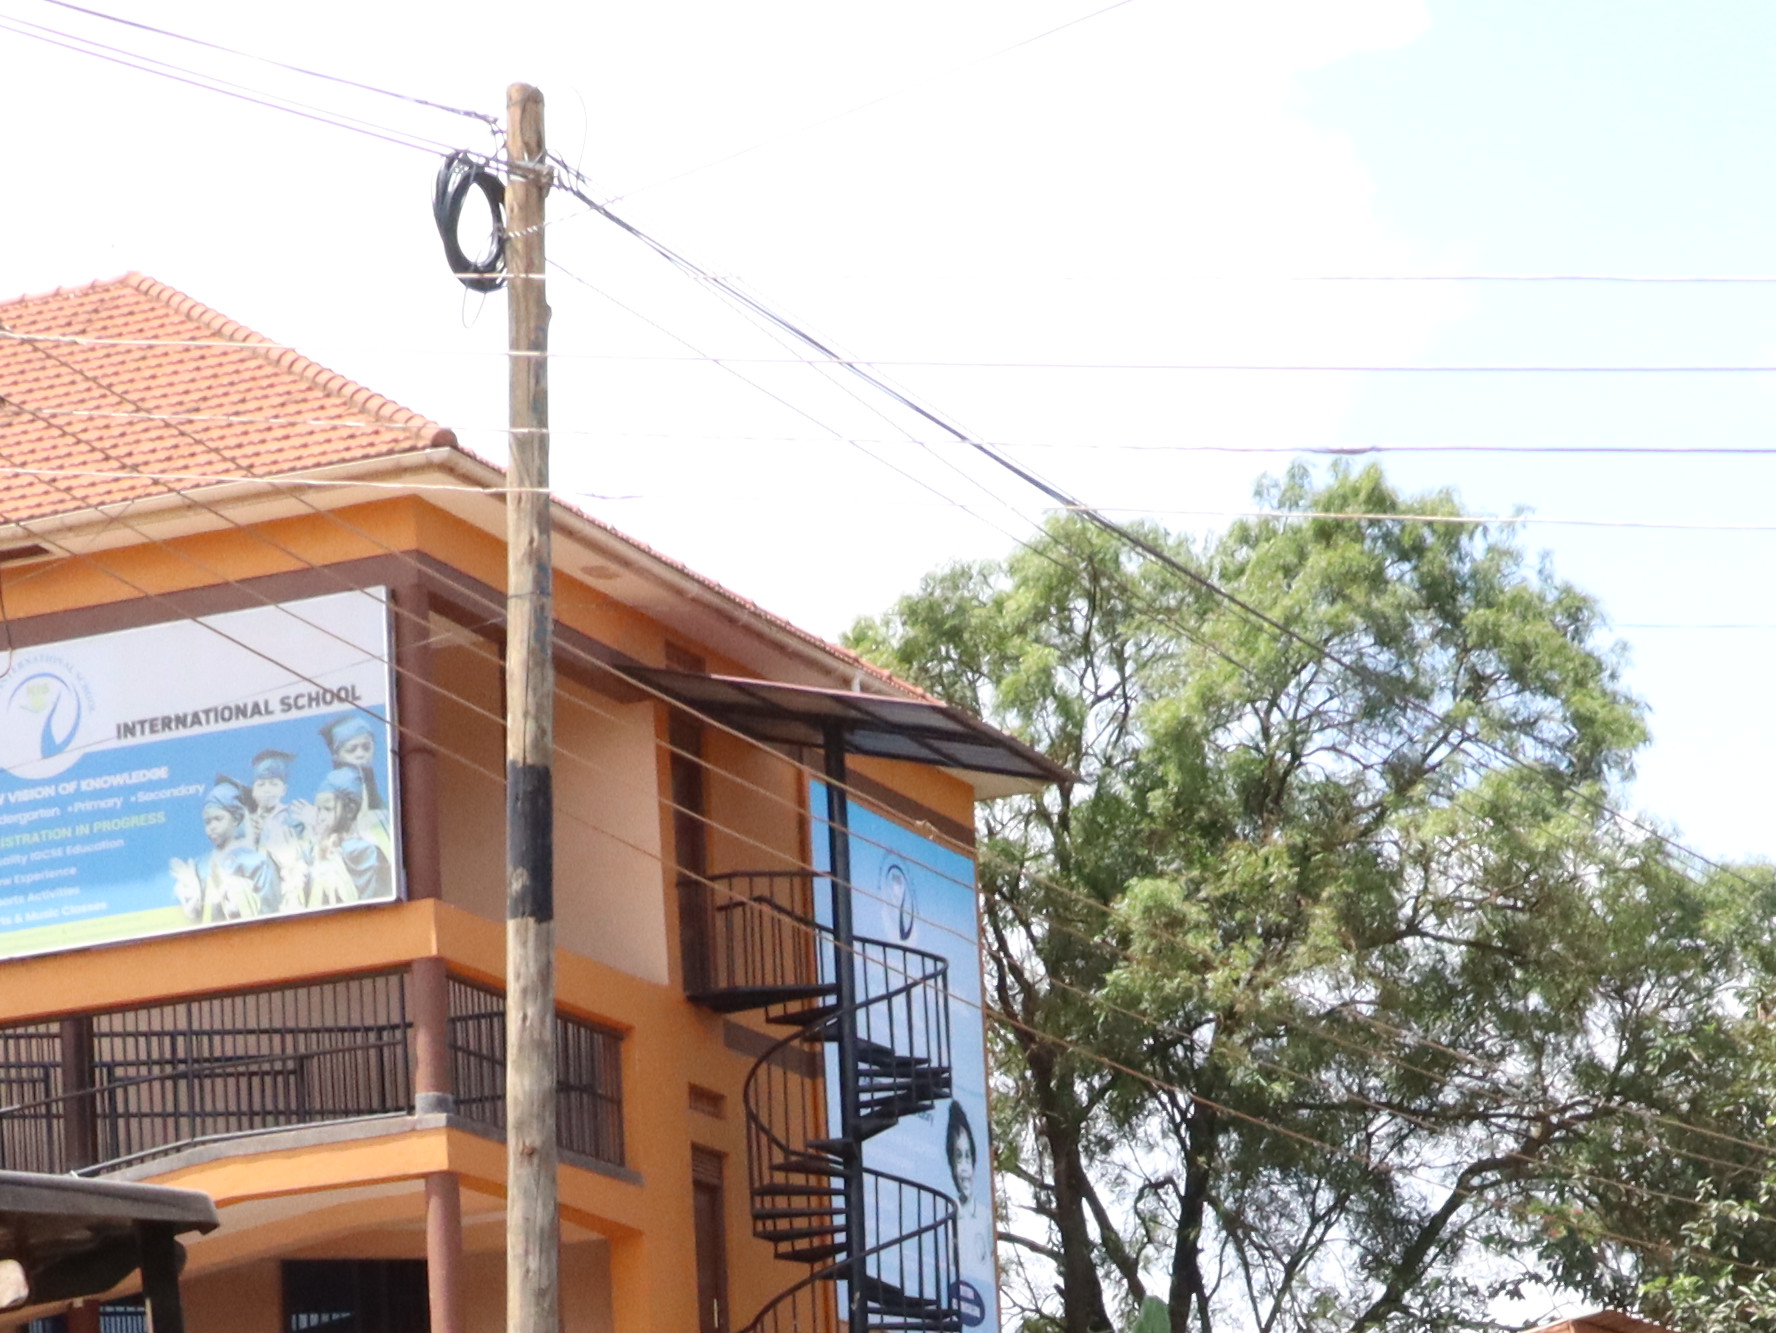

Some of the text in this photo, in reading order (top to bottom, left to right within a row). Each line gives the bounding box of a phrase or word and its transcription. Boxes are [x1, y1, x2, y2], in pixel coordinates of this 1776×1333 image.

[116, 684, 362, 740] INTERNATIONAL SCHOOL
[7, 786, 56, 803] VISION
[58, 781, 78, 795] OF
[80, 766, 169, 792] KNOWLEDGE
[75, 824, 90, 836] IN
[93, 811, 166, 833] PROGRESS
[66, 838, 124, 856] Education
[14, 866, 77, 884] Experience
[27, 886, 81, 903] Activities
[25, 908, 60, 922] Music
[61, 902, 107, 916] Classes
